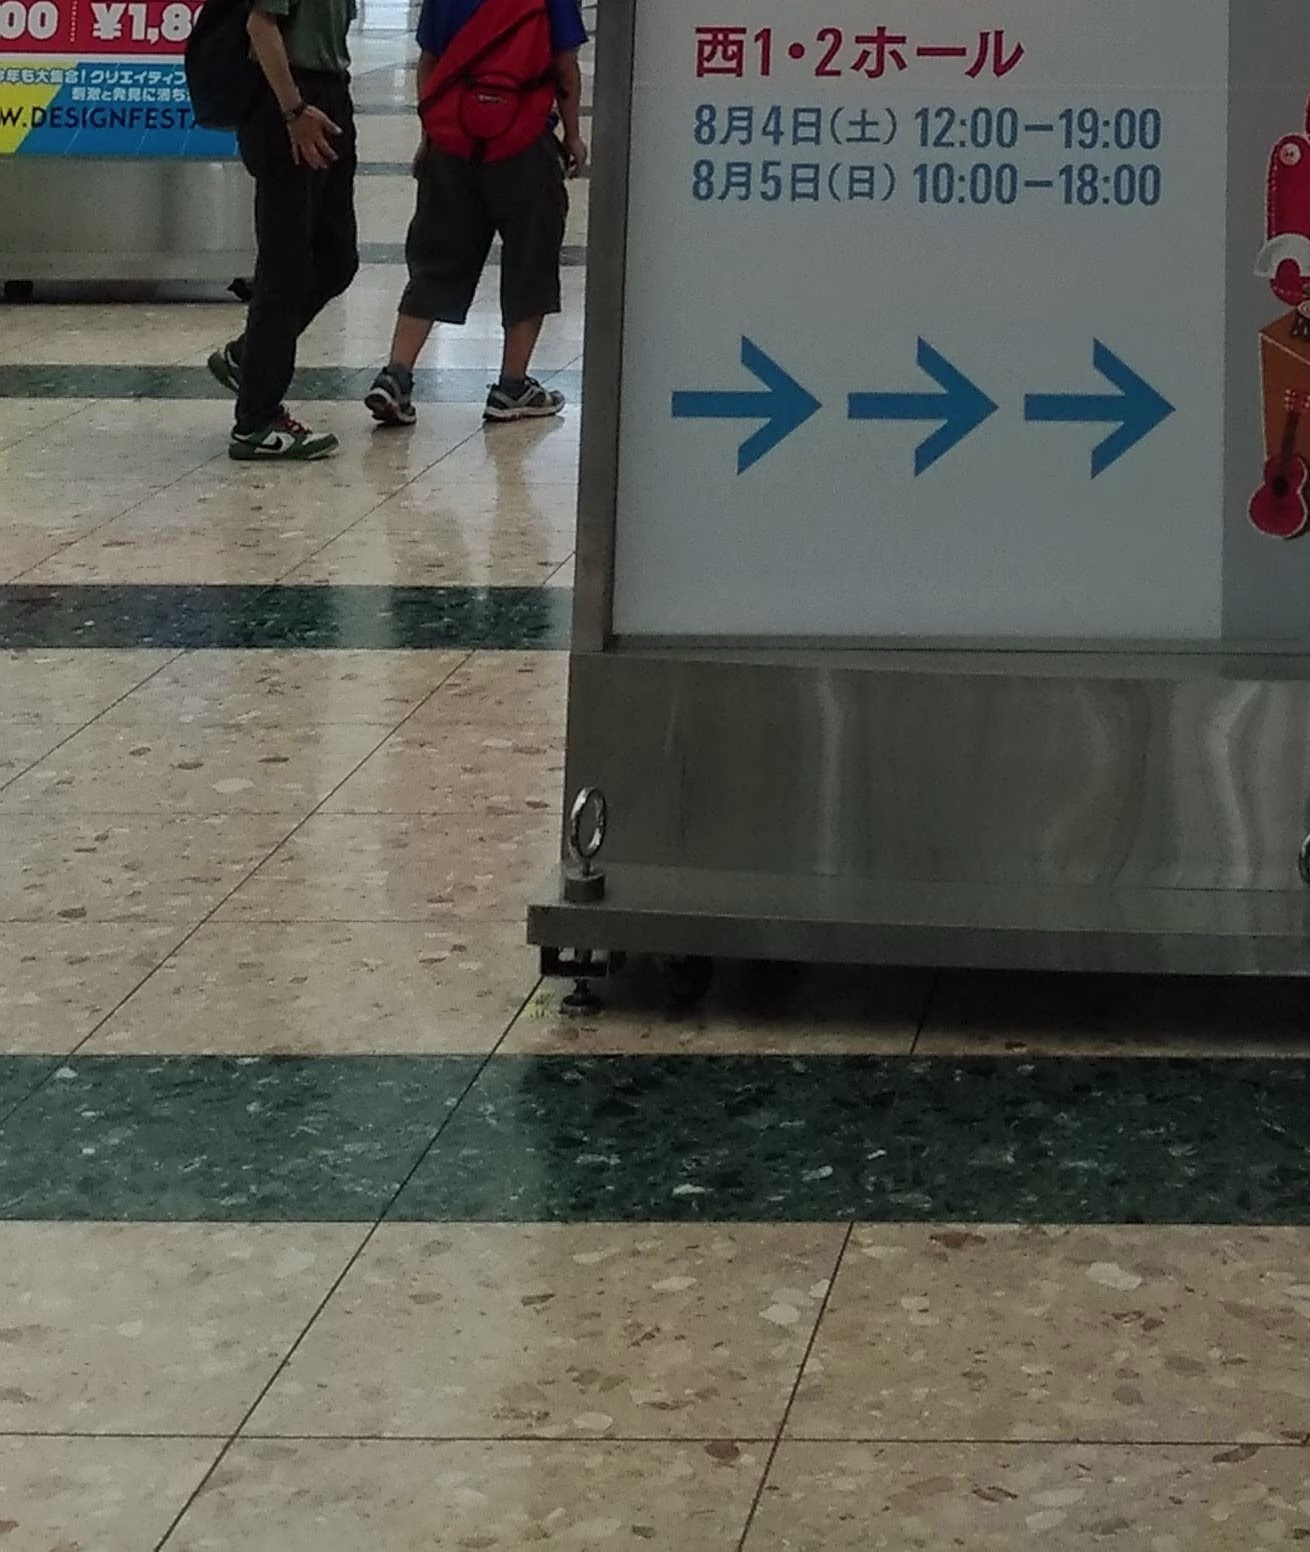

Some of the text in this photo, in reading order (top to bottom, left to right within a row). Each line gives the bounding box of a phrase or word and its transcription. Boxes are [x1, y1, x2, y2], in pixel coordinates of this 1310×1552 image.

[695, 26, 1025, 79] 西1・2ホール
